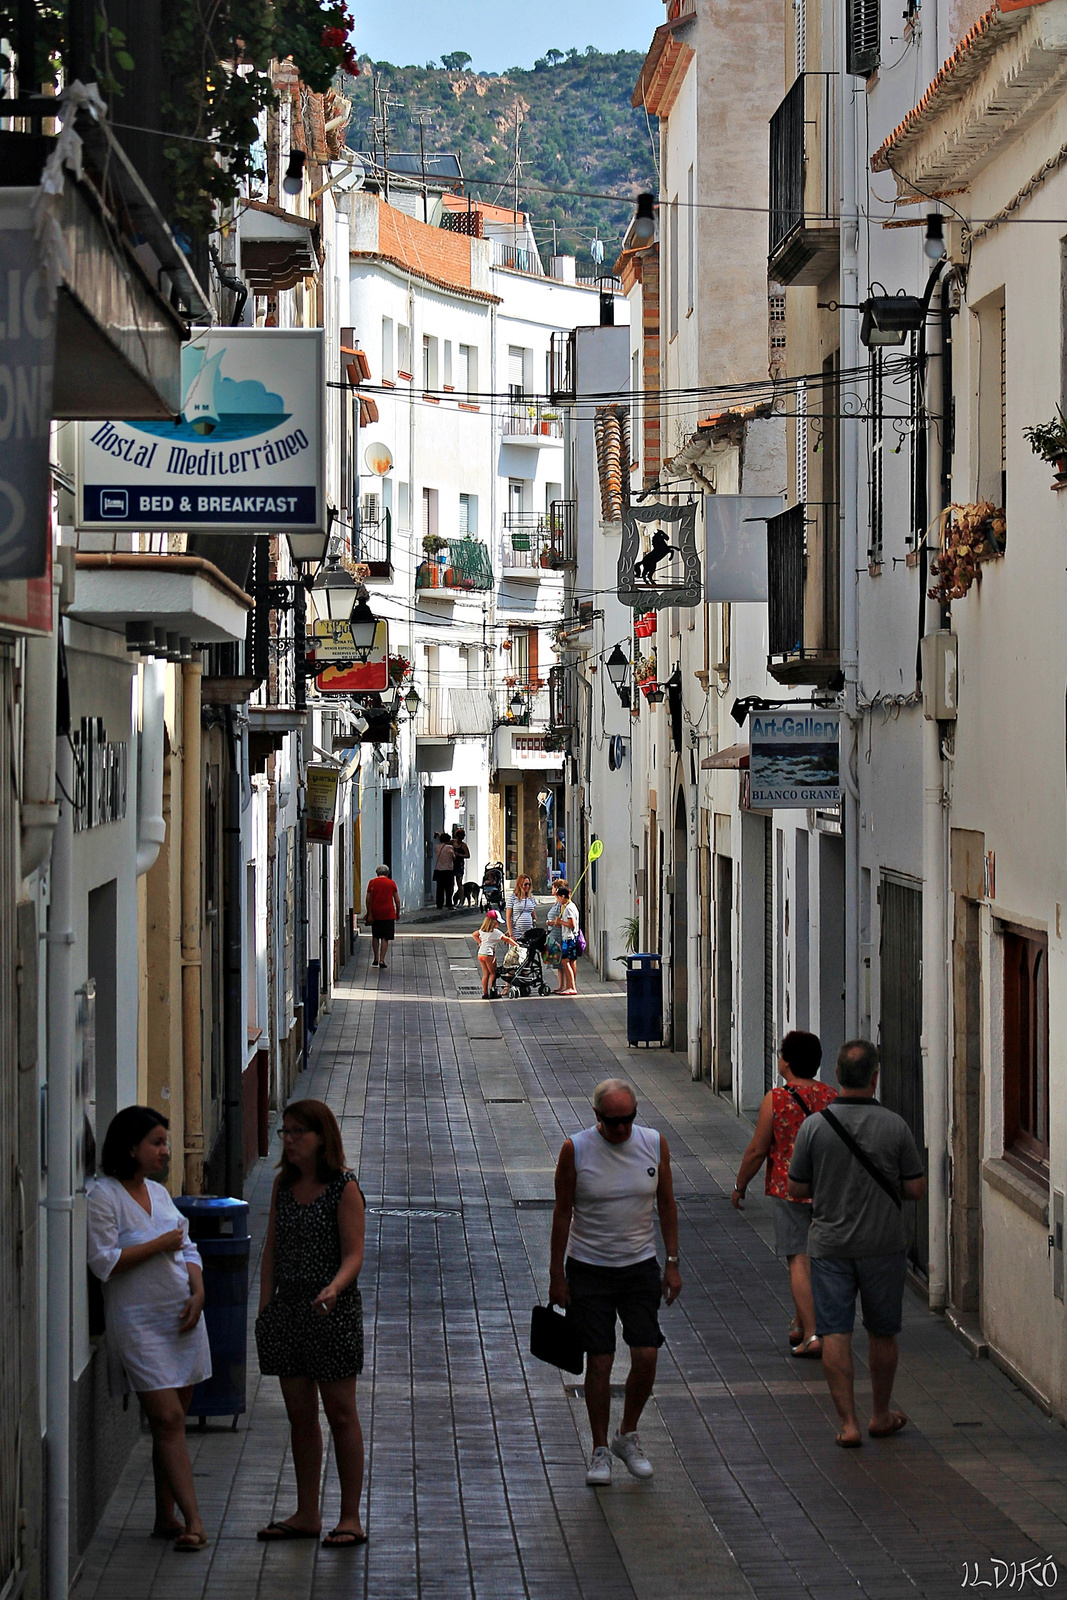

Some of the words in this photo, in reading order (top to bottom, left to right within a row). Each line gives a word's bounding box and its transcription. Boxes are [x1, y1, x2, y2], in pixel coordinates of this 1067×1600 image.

[89, 421, 158, 468] Hostal
[166, 428, 309, 476] Mediterráneo
[139, 496, 174, 512] BED
[179, 496, 192, 512] &
[197, 496, 298, 513] BREAKFAST
[617, 521, 635, 592] VINS
[681, 516, 698, 598] LICORS
[752, 718, 839, 741] Art-Gallery
[752, 790, 798, 800] BLANCO
[800, 787, 840, 800] GRANÉ
